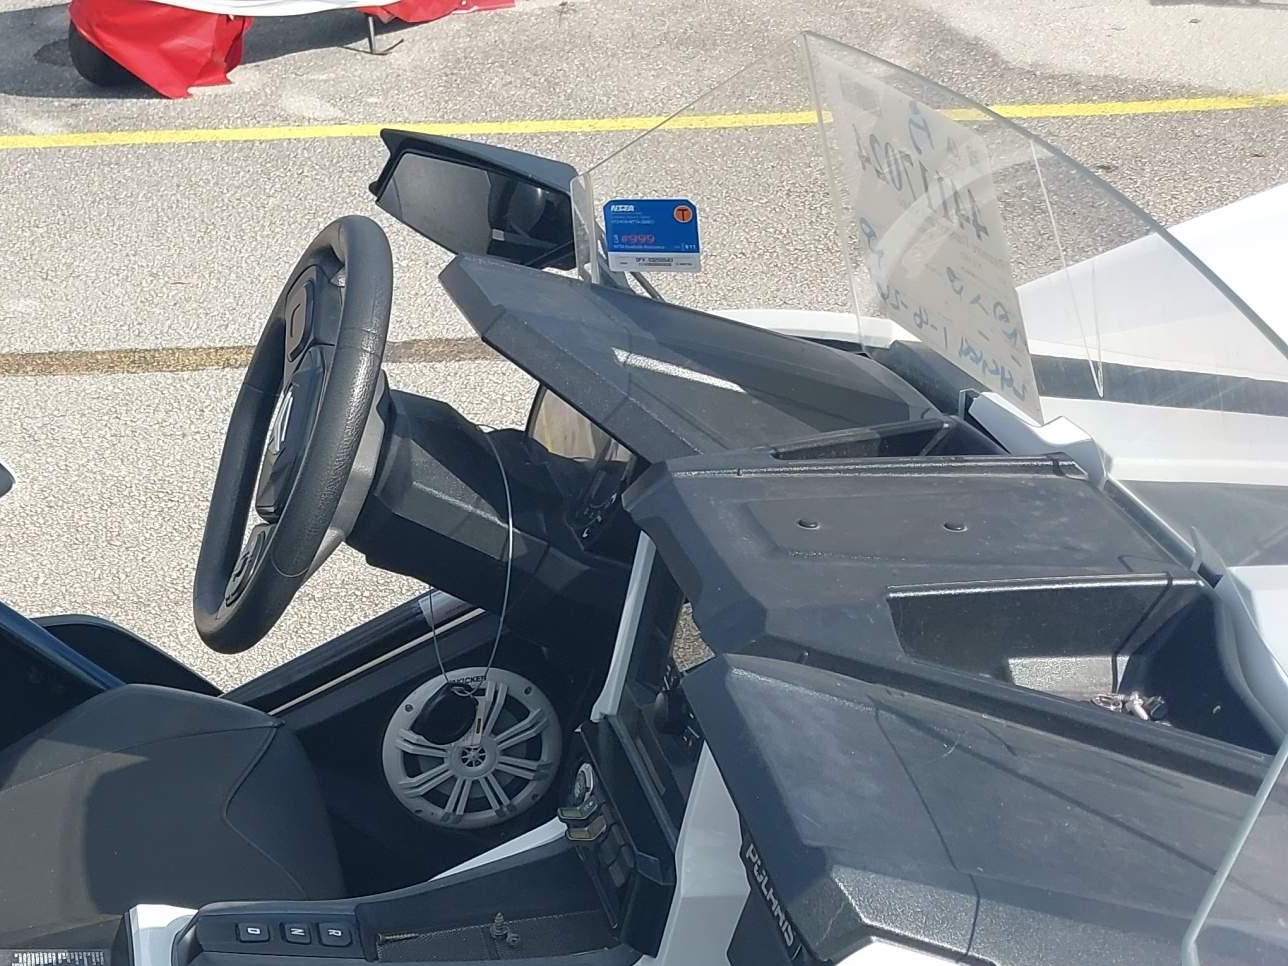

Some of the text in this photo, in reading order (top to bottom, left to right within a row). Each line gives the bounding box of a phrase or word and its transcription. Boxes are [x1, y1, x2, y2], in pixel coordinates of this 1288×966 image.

[745, 842, 795, 947] POLARIS
[247, 927, 261, 935] D
[290, 928, 305, 936] N
[327, 929, 342, 937] R
